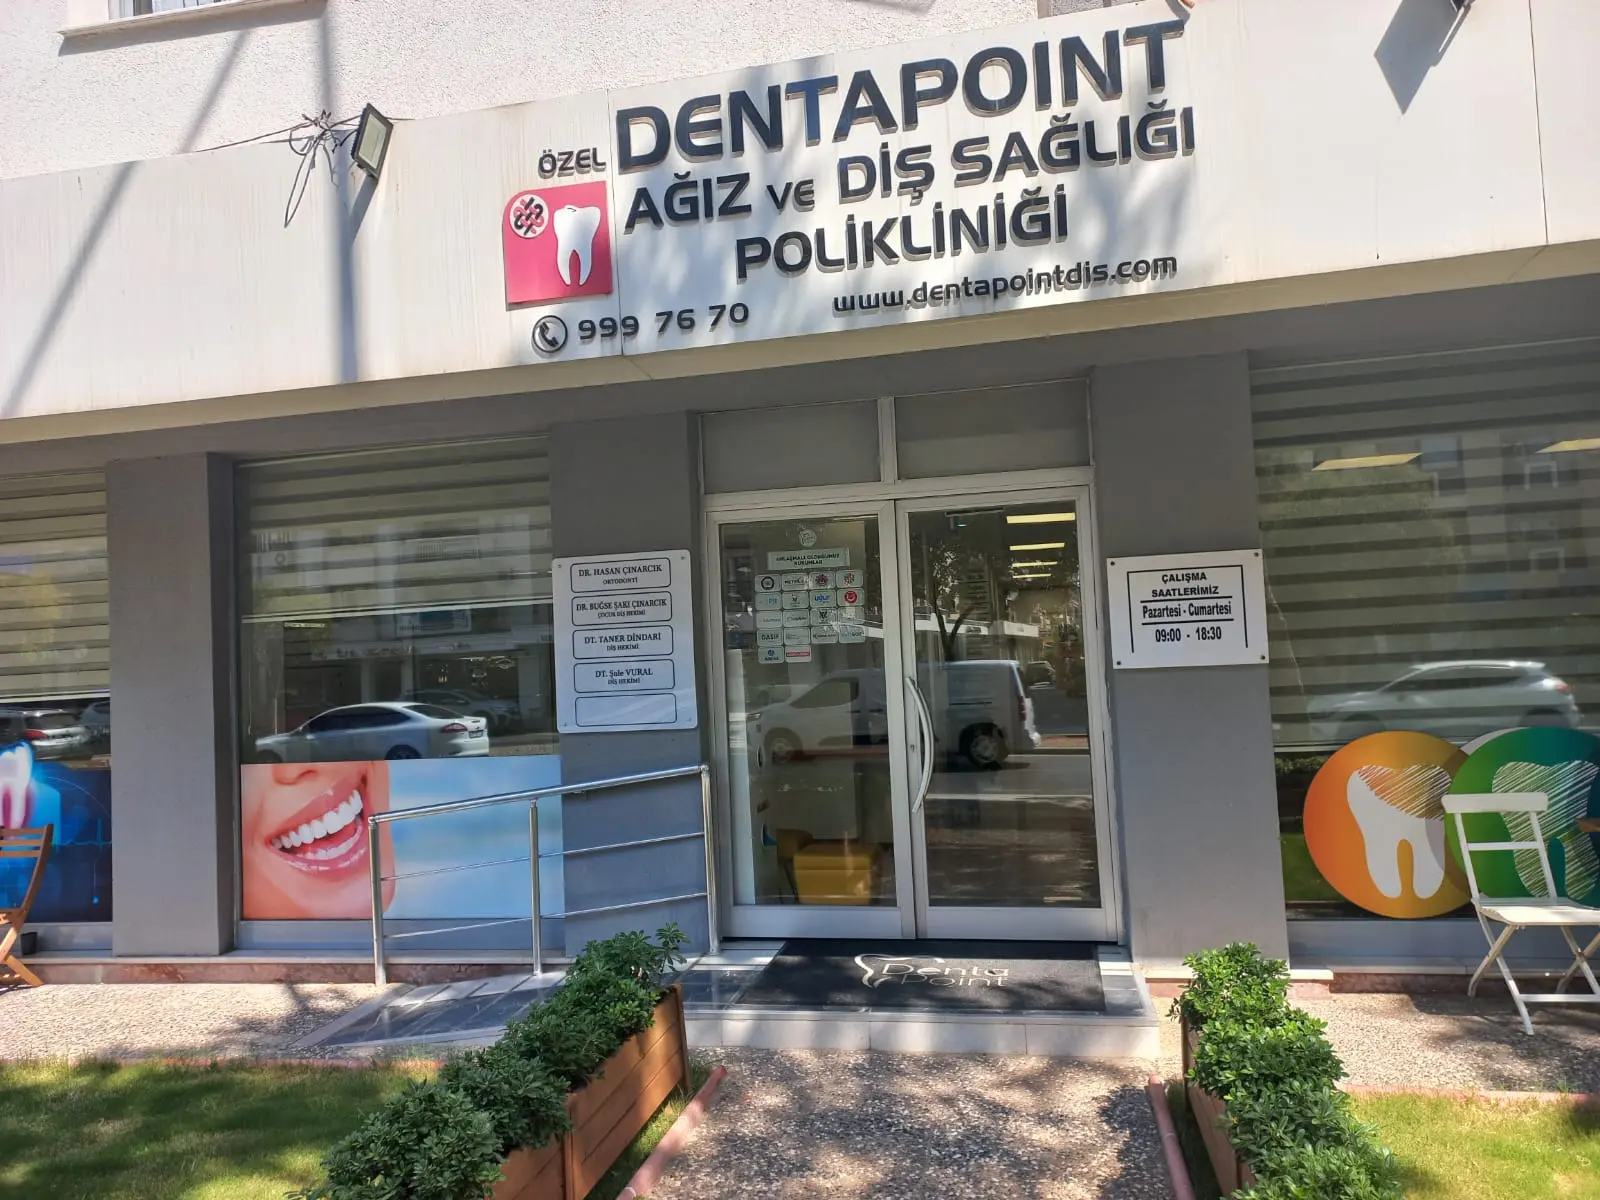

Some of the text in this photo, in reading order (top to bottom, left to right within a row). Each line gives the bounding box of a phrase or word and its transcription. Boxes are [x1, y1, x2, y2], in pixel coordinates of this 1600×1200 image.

[616, 20, 1185, 174] DENTAPOINT
[538, 146, 607, 178] ÖZEL
[624, 172, 753, 234] AĞIZ
[838, 141, 936, 205] DİŞ
[951, 98, 1194, 186] SAĞLIĞI
[735, 183, 1069, 280] POLİKLİNİĞİ
[833, 255, 1178, 314] www.dentapointdis.com
[577, 302, 750, 341] 999 76 70
[578, 564, 662, 577] DR. HASAN ÇINARCIK
[1162, 572, 1207, 584] ÇALIŞMA
[1151, 585, 1220, 598] SAATLERİMİZ
[1142, 603, 1182, 619] Pazartesi
[1188, 601, 1232, 616] Cumartesi
[584, 636, 597, 644] DT.
[599, 634, 625, 643] TANER
[1155, 628, 1182, 643] 09:00
[1196, 626, 1222, 641] 18:30
[595, 670, 608, 678] DT.
[625, 668, 653, 676] VURAL
[882, 963, 1009, 977] Denta
